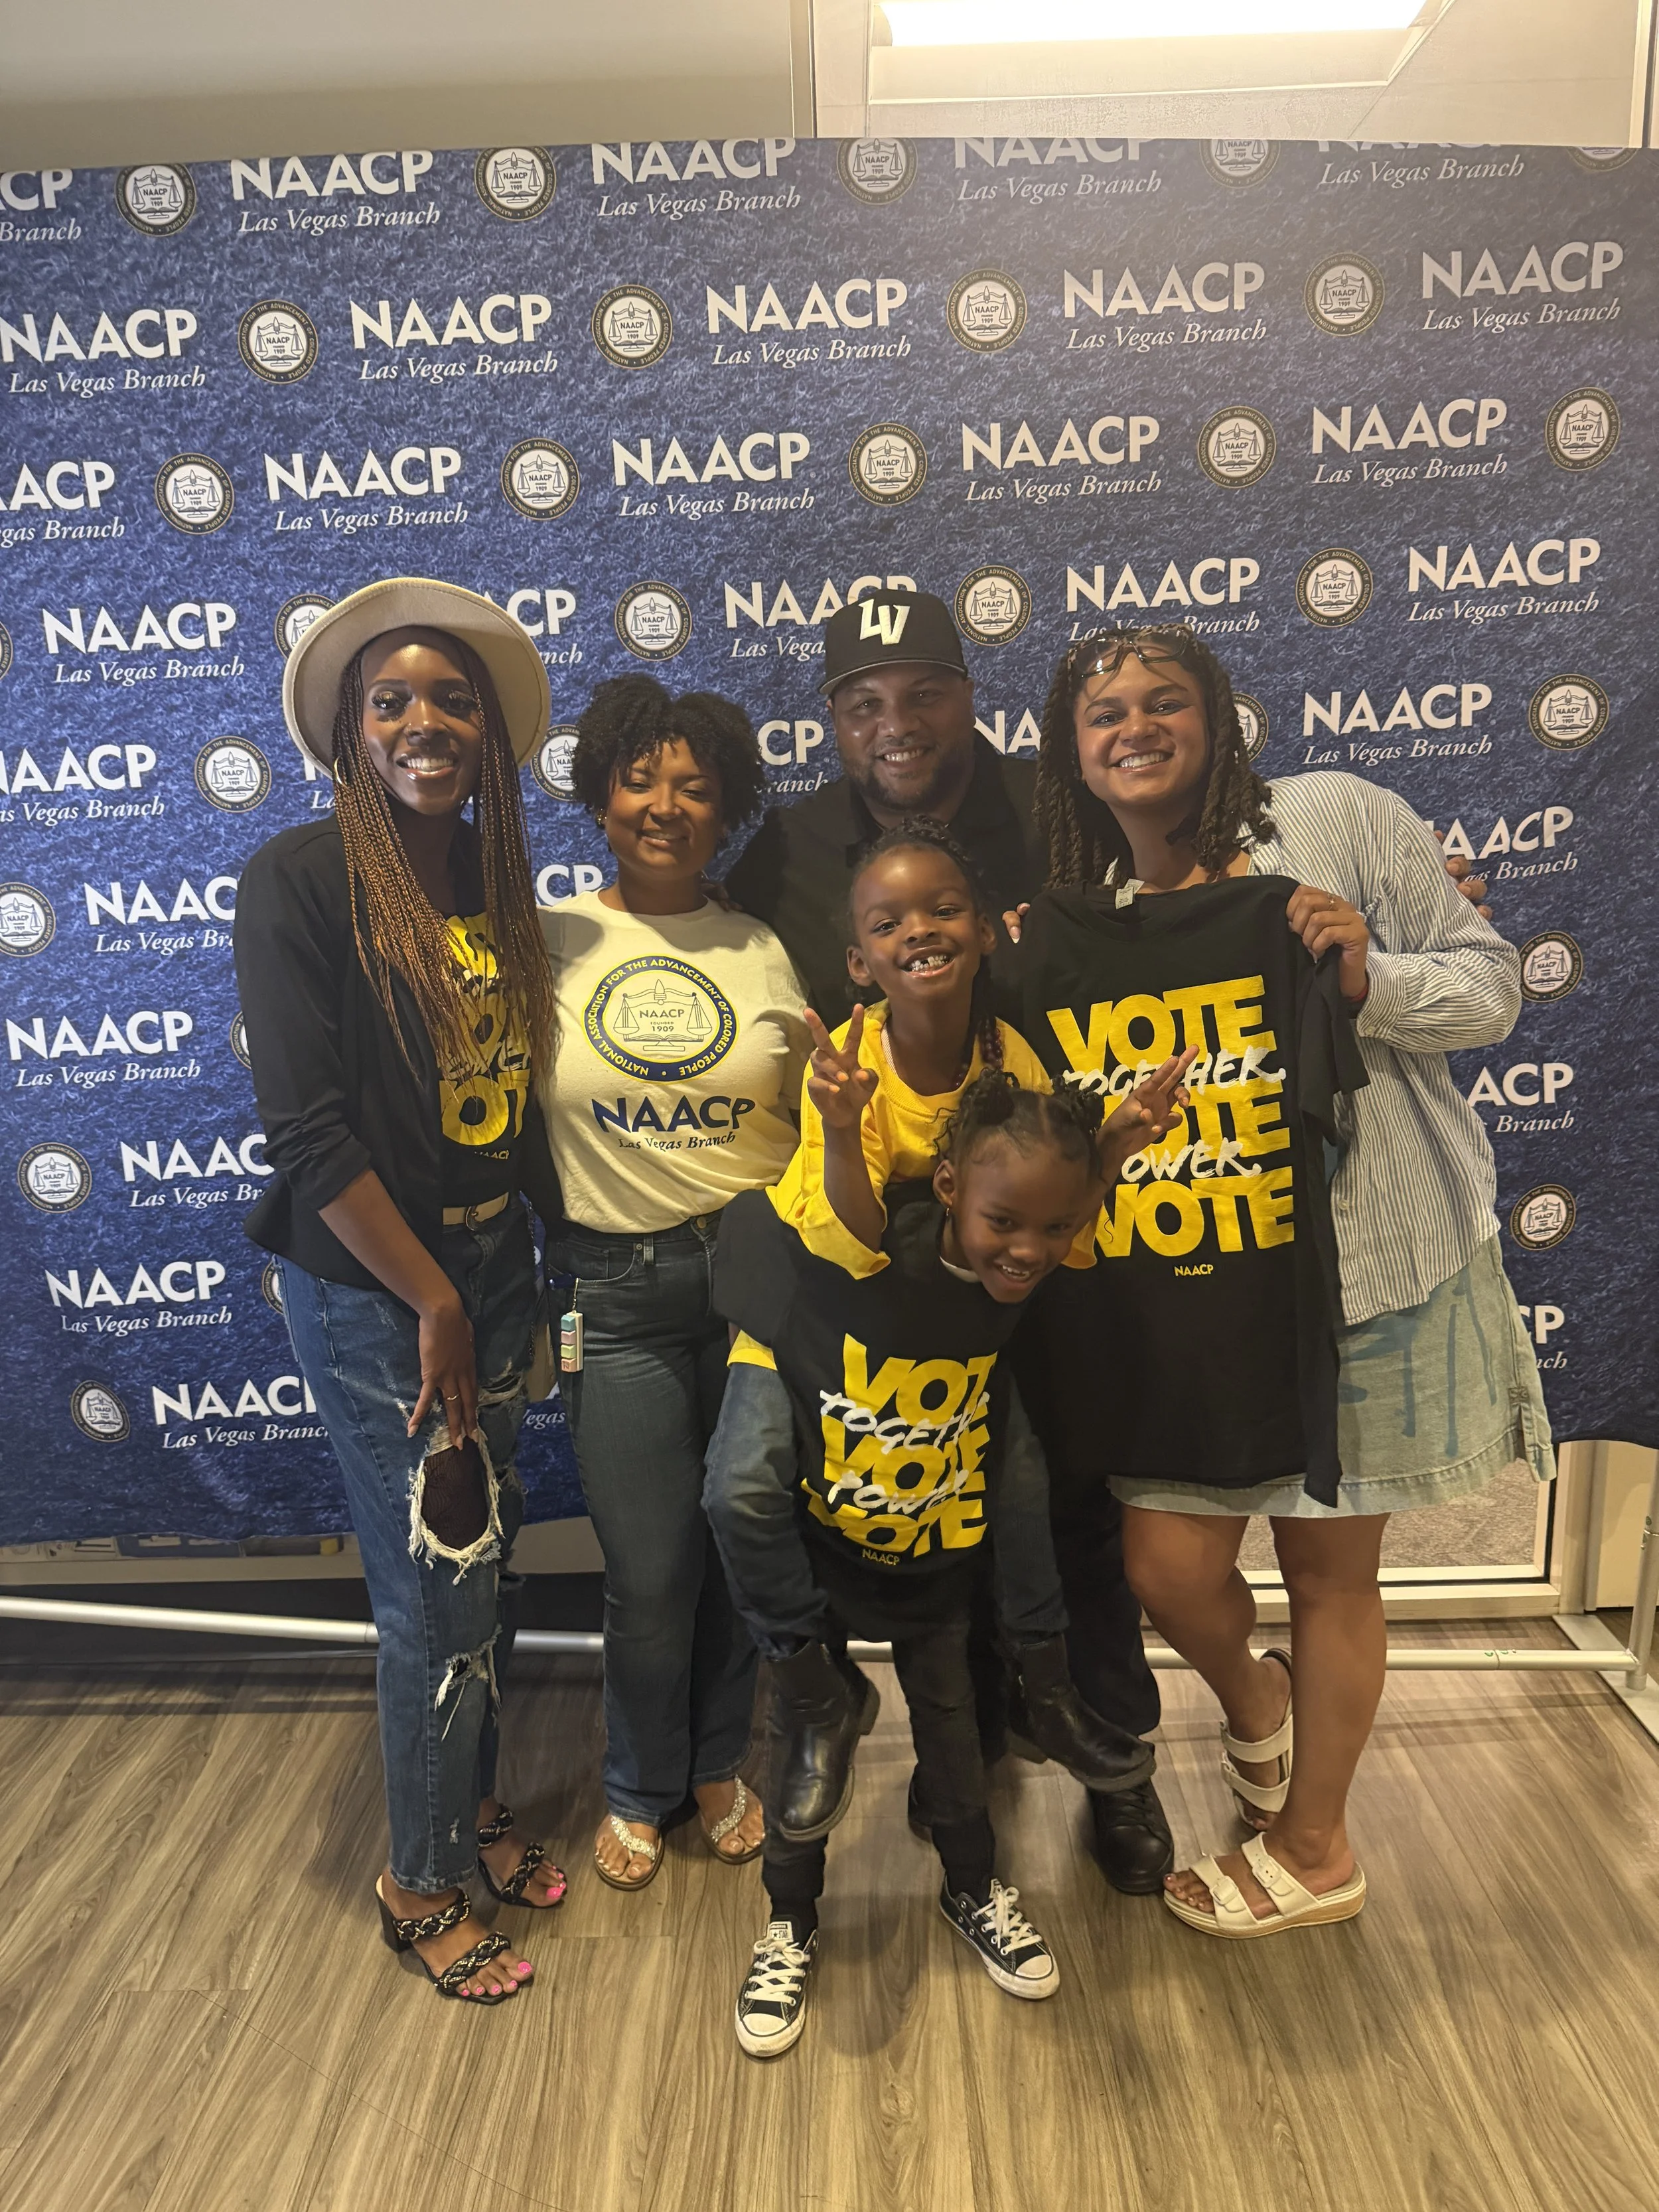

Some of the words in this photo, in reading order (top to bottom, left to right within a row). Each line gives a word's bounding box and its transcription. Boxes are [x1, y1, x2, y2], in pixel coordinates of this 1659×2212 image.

[592, 137, 796, 184] NAACP
[954, 137, 1156, 169] NAACP
[231, 151, 433, 200] NAACP
[958, 180, 997, 200] Las
[1007, 177, 1068, 204] Vegas
[1075, 170, 1161, 194] Branch
[1319, 163, 1360, 185] Las
[1369, 161, 1430, 188] Vegas
[1437, 155, 1524, 179] Branch
[239, 212, 277, 232] Las
[287, 209, 347, 236] Vegas
[355, 202, 439, 226] Branch
[597, 196, 638, 216] Las
[647, 193, 707, 220] Vegas
[714, 186, 800, 211] Branch
[0, 218, 81, 241] Branch
[1423, 242, 1623, 299] NAACP
[707, 279, 907, 333] NAACP
[1064, 263, 1264, 317] NAACP
[350, 294, 551, 348] NAACP
[1422, 309, 1462, 329] Las
[1471, 307, 1530, 333] Vegas
[1537, 298, 1620, 323] Branch
[0, 309, 196, 363] NAACP
[712, 345, 751, 364] Las
[760, 342, 820, 368] Vegas
[827, 335, 910, 359] Branch
[1066, 329, 1106, 348] Las
[1115, 327, 1175, 352] Vegas
[1181, 319, 1266, 343] Branch
[9, 374, 47, 392] Las
[57, 372, 115, 398] Vegas
[123, 366, 205, 390] Branch
[360, 360, 398, 379] Las
[407, 358, 466, 384] Vegas
[473, 351, 557, 375] Branch
[962, 416, 1159, 470] NAACP
[1312, 399, 1506, 453] NAACP
[264, 447, 461, 503] NAACP
[613, 433, 810, 486] NAACP
[1313, 465, 1352, 483] Las
[1362, 461, 1417, 486] Vegas
[1423, 453, 1507, 478] Branch
[0, 461, 114, 510] ACP
[966, 481, 1004, 500] Las
[1013, 479, 1071, 504] Vegas
[1078, 471, 1161, 494] Branch
[275, 511, 312, 530] Las
[321, 508, 378, 534] Vegas
[386, 502, 468, 525] Branch
[619, 496, 658, 516] Las
[667, 494, 724, 520] Vegas
[732, 488, 814, 511] Branch
[0, 528, 35, 548] gas
[44, 516, 124, 539] Branch
[1408, 538, 1600, 591] NAACP
[1067, 558, 1260, 607] NAACP
[858, 599, 910, 645] LV
[1183, 611, 1260, 634] Branch
[1407, 603, 1445, 621] Las
[1455, 600, 1508, 624] Vegas
[1515, 591, 1599, 615] Branch
[42, 603, 236, 654] NAACP
[731, 638, 767, 657] Las
[777, 636, 826, 661] Vega
[55, 664, 92, 682] Las
[99, 662, 157, 686] Vegas
[164, 656, 244, 678] Branch
[1303, 684, 1492, 736] NAACP
[1303, 746, 1340, 764] Las
[1349, 743, 1402, 766] Vegas
[1409, 735, 1492, 757] Branch
[0, 745, 156, 793] AACP
[23, 802, 78, 826] Vegas
[86, 796, 164, 818] Branch
[311, 790, 336, 809] La
[1424, 806, 1573, 861] AACP
[1495, 852, 1577, 879] Branch
[84, 877, 238, 924] NAAC
[95, 934, 131, 952] Las
[138, 932, 194, 955] Vegas
[606, 969, 626, 986] FOR
[625, 960, 648, 972] THE
[650, 959, 722, 1000] ADVANCEMENT
[588, 986, 609, 1040] ASSOCIATION
[639, 1009, 685, 1018] NAACP
[718, 1001, 729, 1011] OF
[1046, 975, 1277, 1070] VOTE
[7, 1011, 192, 1060] NAACP
[715, 1013, 733, 1053] COLORED
[16, 1069, 52, 1086] Las
[60, 1067, 116, 1088] Vegas
[123, 1059, 200, 1080] Branch
[598, 1041, 649, 1076] NATIONAL
[679, 1053, 717, 1076] PEOPLE
[1062, 1045, 1286, 1100] TOGEHER
[1467, 1063, 1573, 1108] ACP
[592, 1095, 755, 1134] NAACP
[1495, 1111, 1573, 1132] Branch
[121, 1134, 274, 1181] NAAC
[619, 1138, 641, 1149] Las
[645, 1138, 682, 1152] Vegas
[687, 1132, 736, 1148] Branch
[1121, 1138, 1262, 1183] OWER
[130, 1191, 165, 1207] Las
[174, 1187, 228, 1209] Vegas
[1095, 1166, 1294, 1258] VOTE
[45, 1261, 225, 1308] NAACP
[1174, 1264, 1214, 1277] NAACP
[96, 1315, 149, 1337] Vegas
[157, 1306, 232, 1327] Branch
[163, 1431, 198, 1448] Las
[206, 1427, 255, 1446] Vegas
[263, 1424, 328, 1440] Branc
[862, 1548, 900, 1566] NAACP
